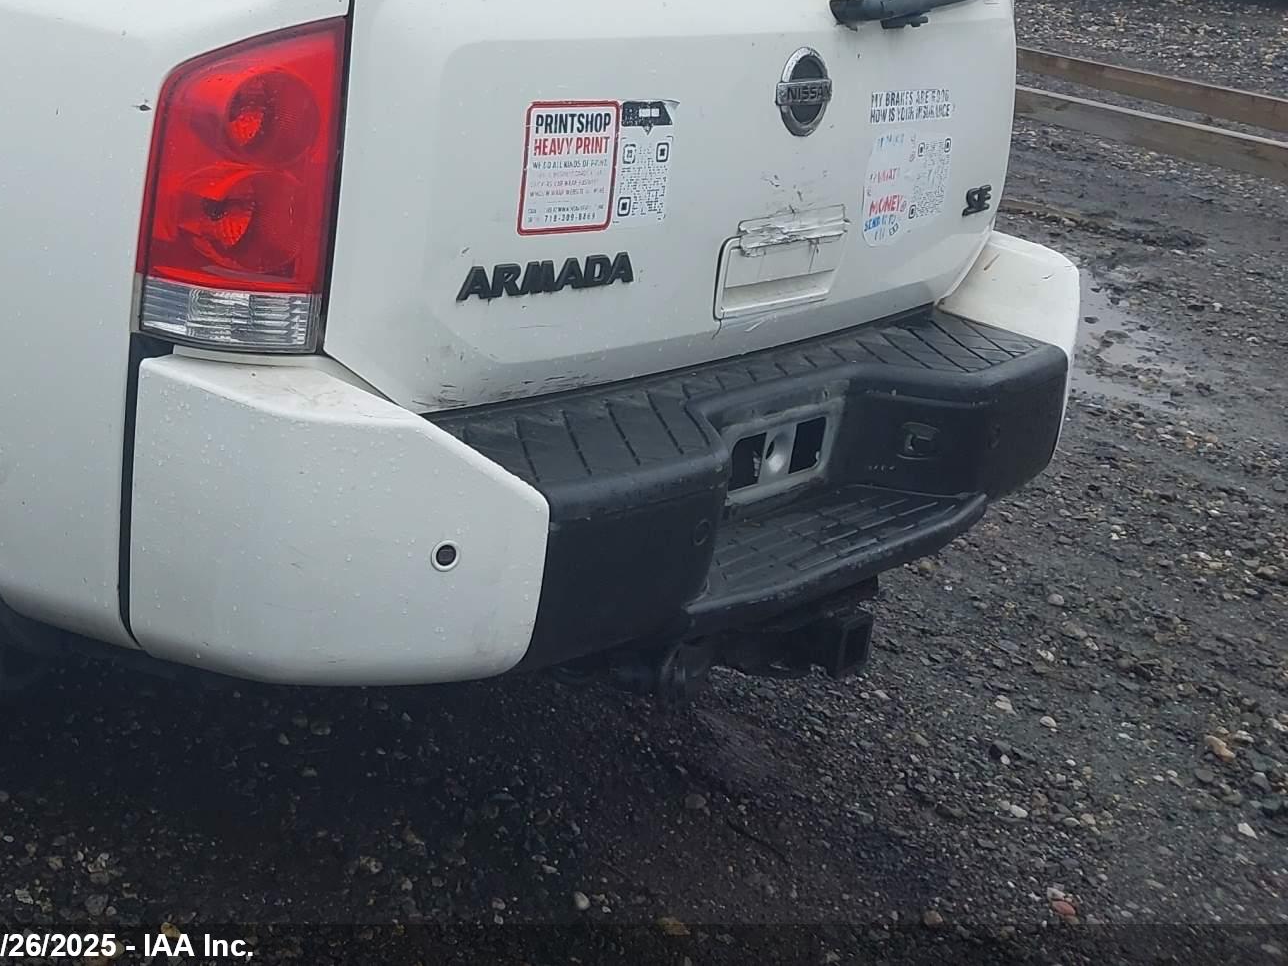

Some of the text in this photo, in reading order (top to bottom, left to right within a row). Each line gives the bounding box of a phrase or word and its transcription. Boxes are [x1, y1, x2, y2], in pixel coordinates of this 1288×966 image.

[535, 113, 612, 135] PRINTSHOP
[533, 136, 611, 156] HEAVY PRINT
[962, 184, 992, 218] SE
[456, 251, 634, 303] ARMADA
